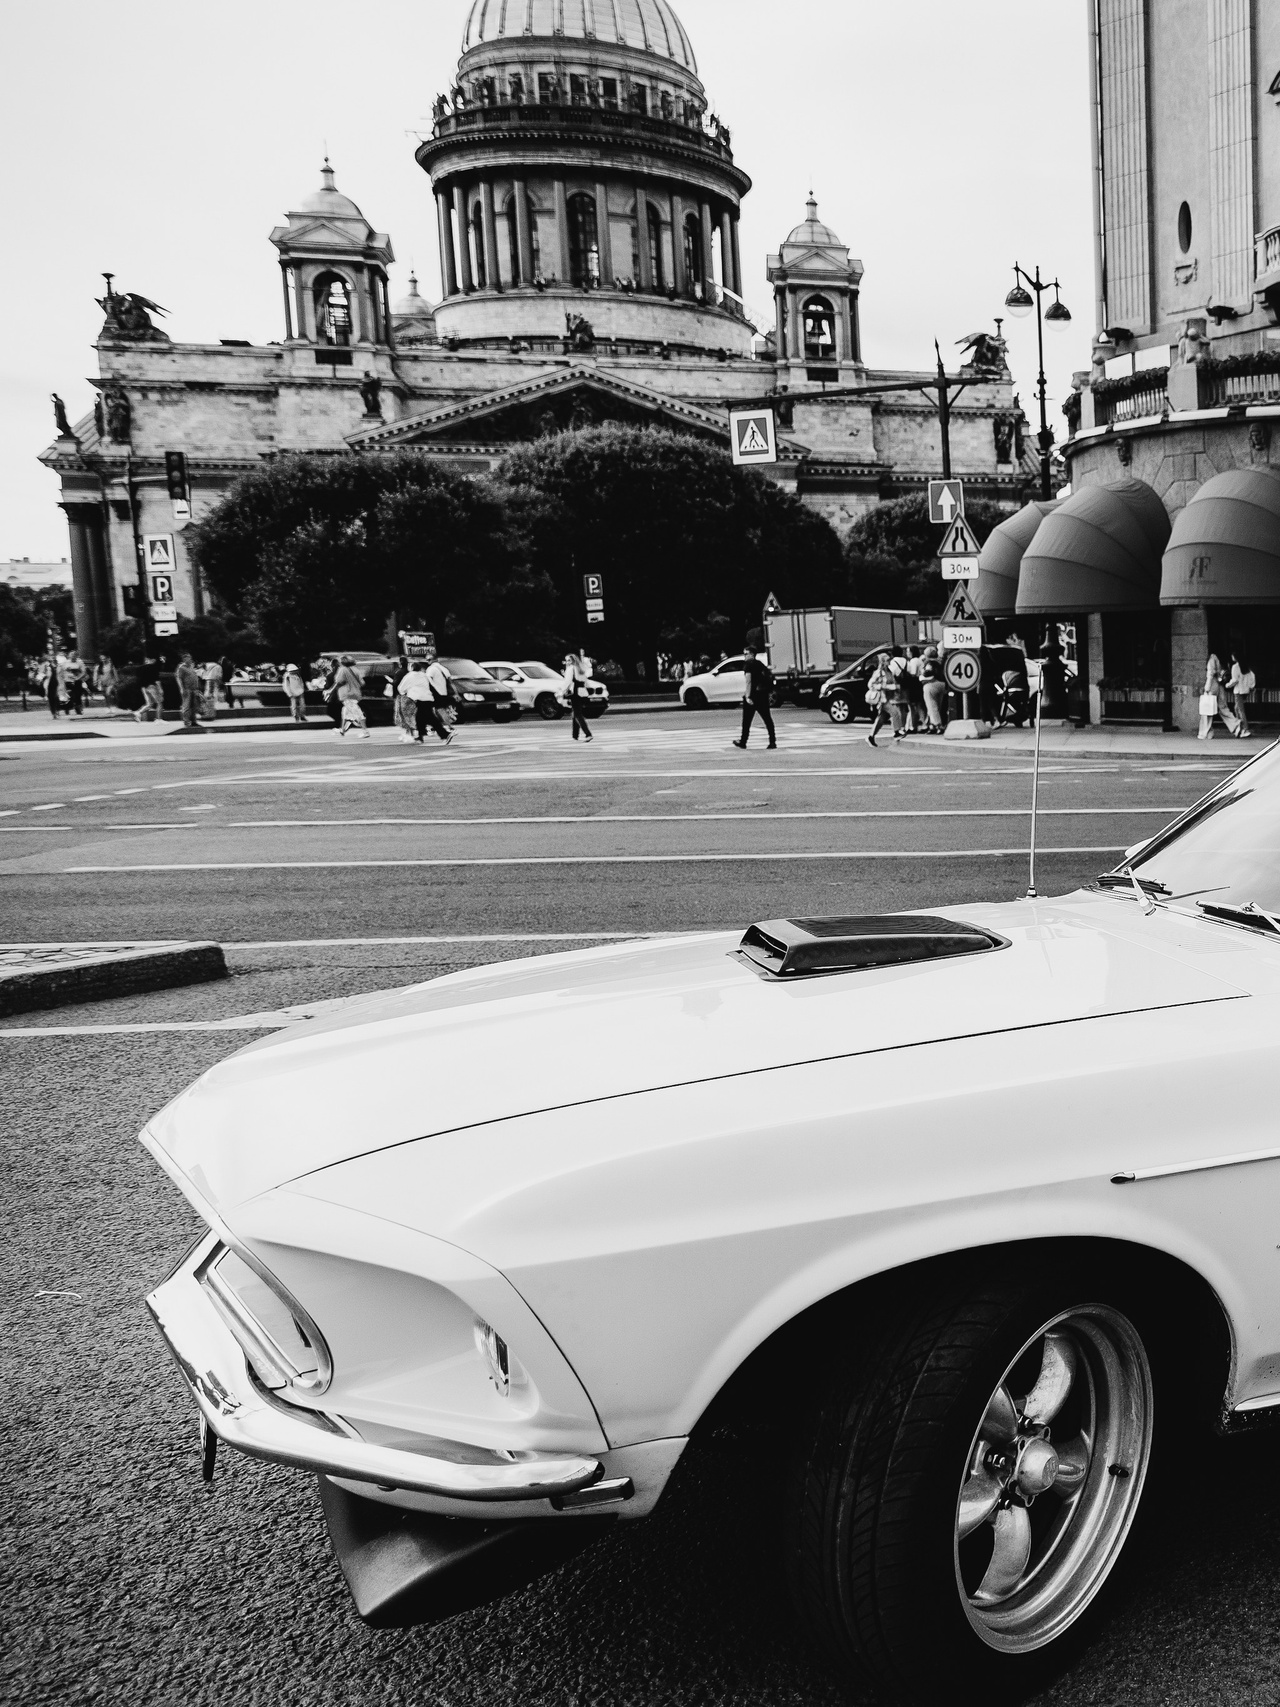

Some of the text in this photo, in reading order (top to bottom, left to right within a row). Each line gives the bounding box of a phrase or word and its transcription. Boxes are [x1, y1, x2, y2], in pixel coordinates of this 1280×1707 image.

[156, 577, 170, 600] P
[588, 577, 599, 594] P
[952, 662, 974, 680] 40
